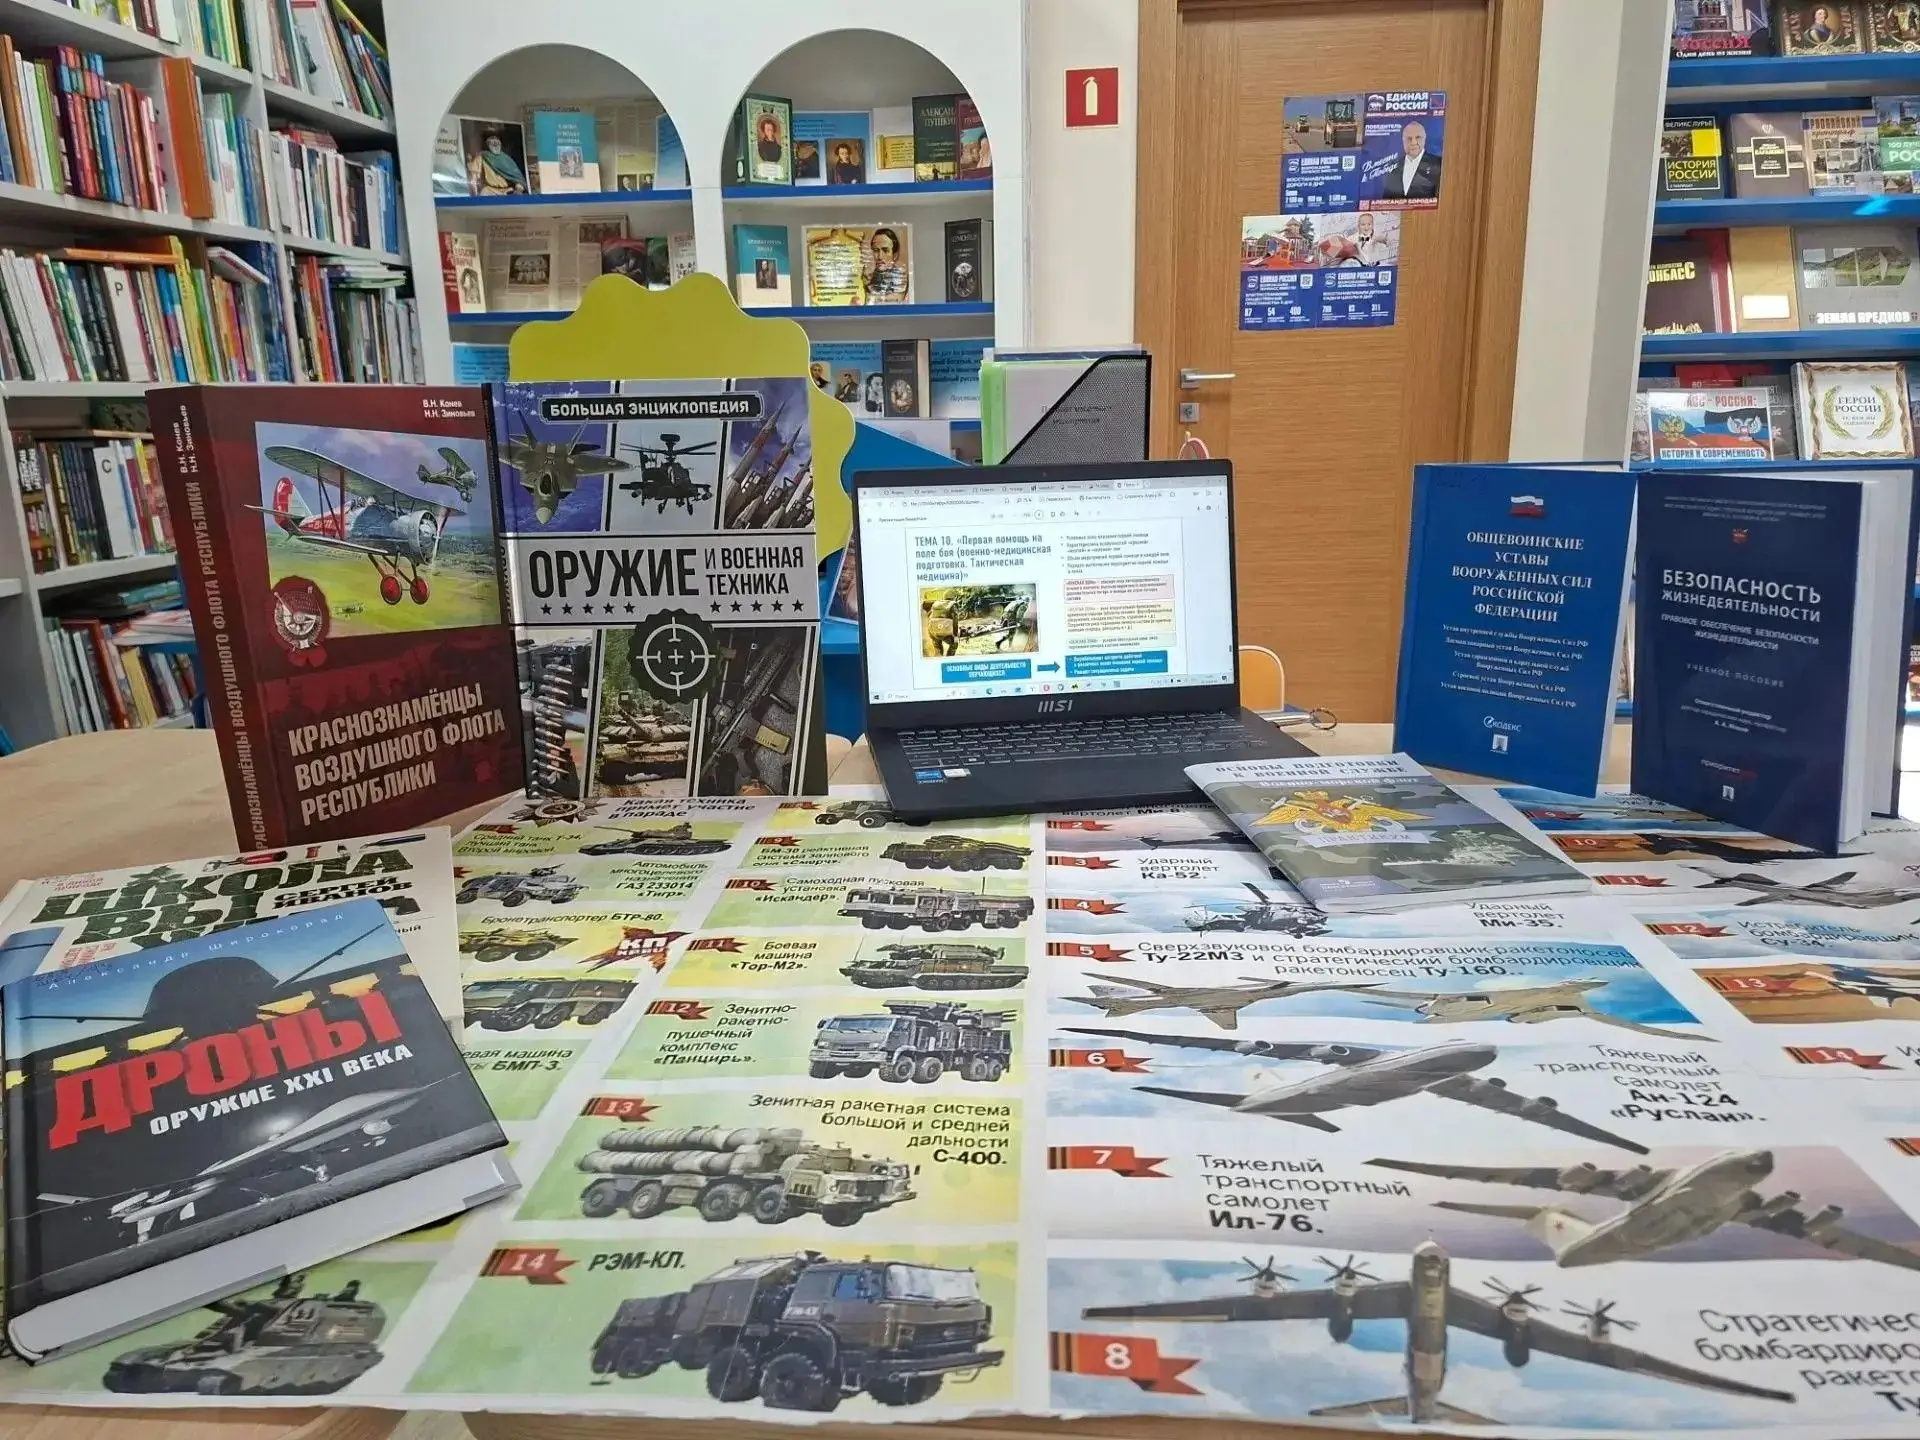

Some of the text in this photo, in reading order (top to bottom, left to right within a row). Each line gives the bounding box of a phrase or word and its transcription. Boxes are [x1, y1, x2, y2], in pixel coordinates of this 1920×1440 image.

[1386, 92, 1428, 102] ЕДИНАЯ
[1386, 102, 1428, 111] РОССИЯ
[1667, 160, 1716, 170] ИСТОРИЯ
[1668, 169, 1717, 180] РОССИИ
[1647, 261, 1696, 283] ОНБАСС
[115, 281, 124, 295] Р
[1817, 311, 1910, 324] ЗЕМЛЯ ПРЕДКОВ
[439, 400, 462, 408] Конев
[1838, 396, 1876, 404] ГЕРОИ
[440, 409, 476, 418] Зиновьев
[550, 400, 749, 417] БОЛЬШАЯ ЭНЦИКЛОПЕДИЯ
[1835, 404, 1880, 413] РОССИИ
[1661, 448, 1765, 458] ИСТОРИЯ СОВРЕМЕННОСТЬ
[915, 534, 1043, 547] ТЕМА помощь на
[1467, 531, 1584, 550] ОБЩЕВОИНСКИЕ
[915, 545, 1051, 559] поле боя (военно-медицинская
[1495, 551, 1549, 566] УСТАВЫ
[916, 557, 1024, 571] подготовка. Тактическая
[529, 546, 804, 599] ОРУЖИЕ И ВОЕННАЯ
[917, 570, 968, 582] медицина)»
[1452, 565, 1592, 588] ВООРУЖЕННЫХ СИЛ
[706, 572, 789, 596] ТЕХНИКА
[1663, 569, 1821, 604] БЕЗОПАСНОСТЬ
[1472, 585, 1564, 605] РОССИЙСКОЙ
[187, 481, 247, 728] ВОЗДУШНОГО ФЛОТА РЕСПУБЛИКИ
[1661, 589, 1820, 623] ЖИЗНЕДЕЯТЕЛЬНОСТИ
[1475, 603, 1557, 622] ФЕДЕРАЦИИ
[1661, 613, 1819, 645] ПРАВОВОЕ ОБЕСПЕЧЕНИЕ БЕЗОПАСНОСТИ
[1694, 630, 1779, 650] ЖИЗНЕДЕЯТЕЛЬНОСТИ
[1686, 662, 1785, 687] УЧЕБНОЕ ПОСОБИЕ
[288, 682, 483, 757] КРАСНОЗНАМЁНЦЫ
[295, 708, 506, 791] ВОЗДУШНОГО ФЛОТА
[1215, 759, 1401, 773] ОСНОВЫ ПОДГОТОВКИ
[1253, 769, 1330, 777] ВОЕННОЙ
[1340, 767, 1408, 775] СЛУЖБЕ
[301, 760, 437, 826] РЕСПУБЛИКИ
[615, 804, 679, 812] примет
[622, 810, 688, 819] параде
[1061, 809, 1131, 817] вертолет
[1574, 838, 1597, 846] 10
[632, 861, 709, 870] Автомобиль
[1075, 858, 1087, 866] 3
[1137, 857, 1213, 865] Ударный
[1140, 865, 1220, 873] вертолет
[1141, 872, 1207, 880] Ка-52.
[30, 848, 414, 924] ШКОЛА
[616, 881, 694, 890] ГАЗ 233014
[743, 880, 761, 888] 10
[786, 875, 865, 886] Самоходная
[273, 877, 398, 901] СЕРГЕЙ
[273, 882, 413, 909] ИВАНОВ
[783, 886, 847, 896] установка
[755, 894, 840, 903] «Искандер».
[1076, 899, 1091, 910] 4
[1463, 901, 1553, 913] Ударный
[1473, 910, 1565, 921] вертолет
[1479, 918, 1564, 929] Ми-35.
[1671, 924, 1698, 934] 12
[208, 912, 345, 953] Широкорад
[1749, 929, 1920, 944] бомбардировщик
[764, 941, 817, 951] Боевая
[1079, 945, 1094, 956] 5
[1138, 941, 1296, 955] Сверхзвуковой
[754, 951, 813, 960] машина
[1142, 951, 1641, 970] Ту-22М3 и стратегический бомбардировщик
[730, 961, 808, 973] «Тор-М2».
[1275, 966, 1416, 979] ракетоносец
[1736, 976, 1767, 989] 13
[667, 1002, 691, 1014] 12
[723, 1002, 798, 1015] Зенитно-
[717, 1016, 788, 1030] ракетно-
[666, 1028, 752, 1043] пушечный
[511, 1046, 573, 1059] машина
[659, 1042, 738, 1055] комплекс
[1588, 1043, 1707, 1064] Тяжелый
[1814, 1048, 1848, 1061] 14
[491, 1057, 562, 1073] БМП-3.
[653, 1053, 758, 1067] «Панцирь».
[1087, 1052, 1106, 1065] 6
[48, 990, 403, 1151] ДРОНЫ
[1534, 1061, 1721, 1078] транспортный
[150, 1042, 414, 1137] ОРУЖИЕ XXI ВЕКА
[1613, 1075, 1722, 1092] самолет
[1629, 1089, 1739, 1107] Ан-124
[604, 1100, 634, 1116] 13
[748, 1094, 1011, 1117] Зенитная ракетная система
[1610, 1104, 1768, 1123] «Руслан».
[821, 1111, 1010, 1136] большой и средней
[907, 1133, 1009, 1151] дальности
[933, 1148, 1008, 1165] С-400.
[1092, 1149, 1113, 1166] 7
[1196, 1153, 1324, 1174] Тяжелый
[1200, 1173, 1412, 1198] транспортный
[1206, 1192, 1331, 1213] самолет
[1209, 1210, 1325, 1234] Ил-76.
[511, 1252, 545, 1270] 14
[587, 1249, 687, 1272] РЭМ-КЛ.
[1104, 1343, 1132, 1370] 8
